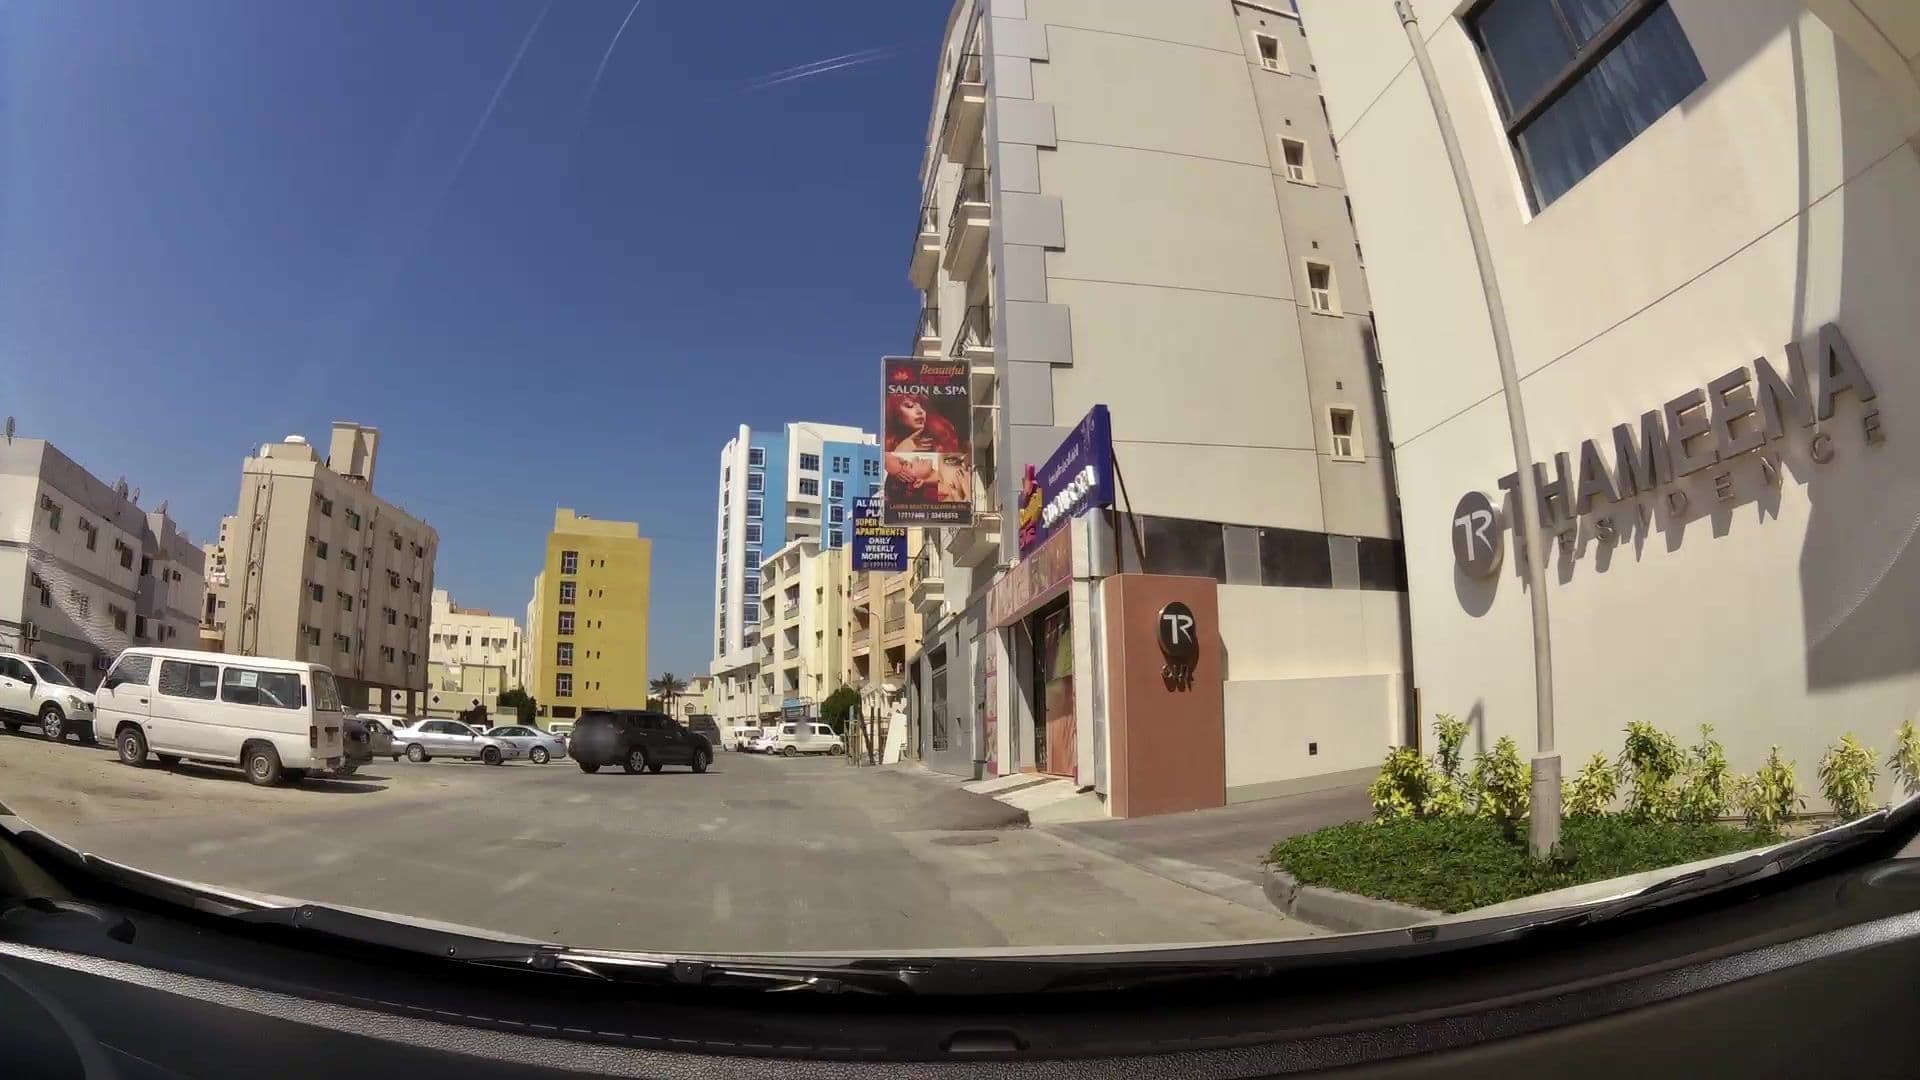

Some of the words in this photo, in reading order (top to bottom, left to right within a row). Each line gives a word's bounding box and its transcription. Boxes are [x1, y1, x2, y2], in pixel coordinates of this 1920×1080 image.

[920, 363, 965, 377] Beautiful
[888, 384, 929, 395] SALON
[933, 385, 942, 395] &
[945, 385, 967, 395] SPA
[1498, 322, 1877, 538] THAMEENA
[1524, 408, 1885, 564] ESIDENCE
[856, 499, 867, 507] AL
[856, 518, 878, 526] SUPER
[856, 527, 905, 536] APARTMENTS
